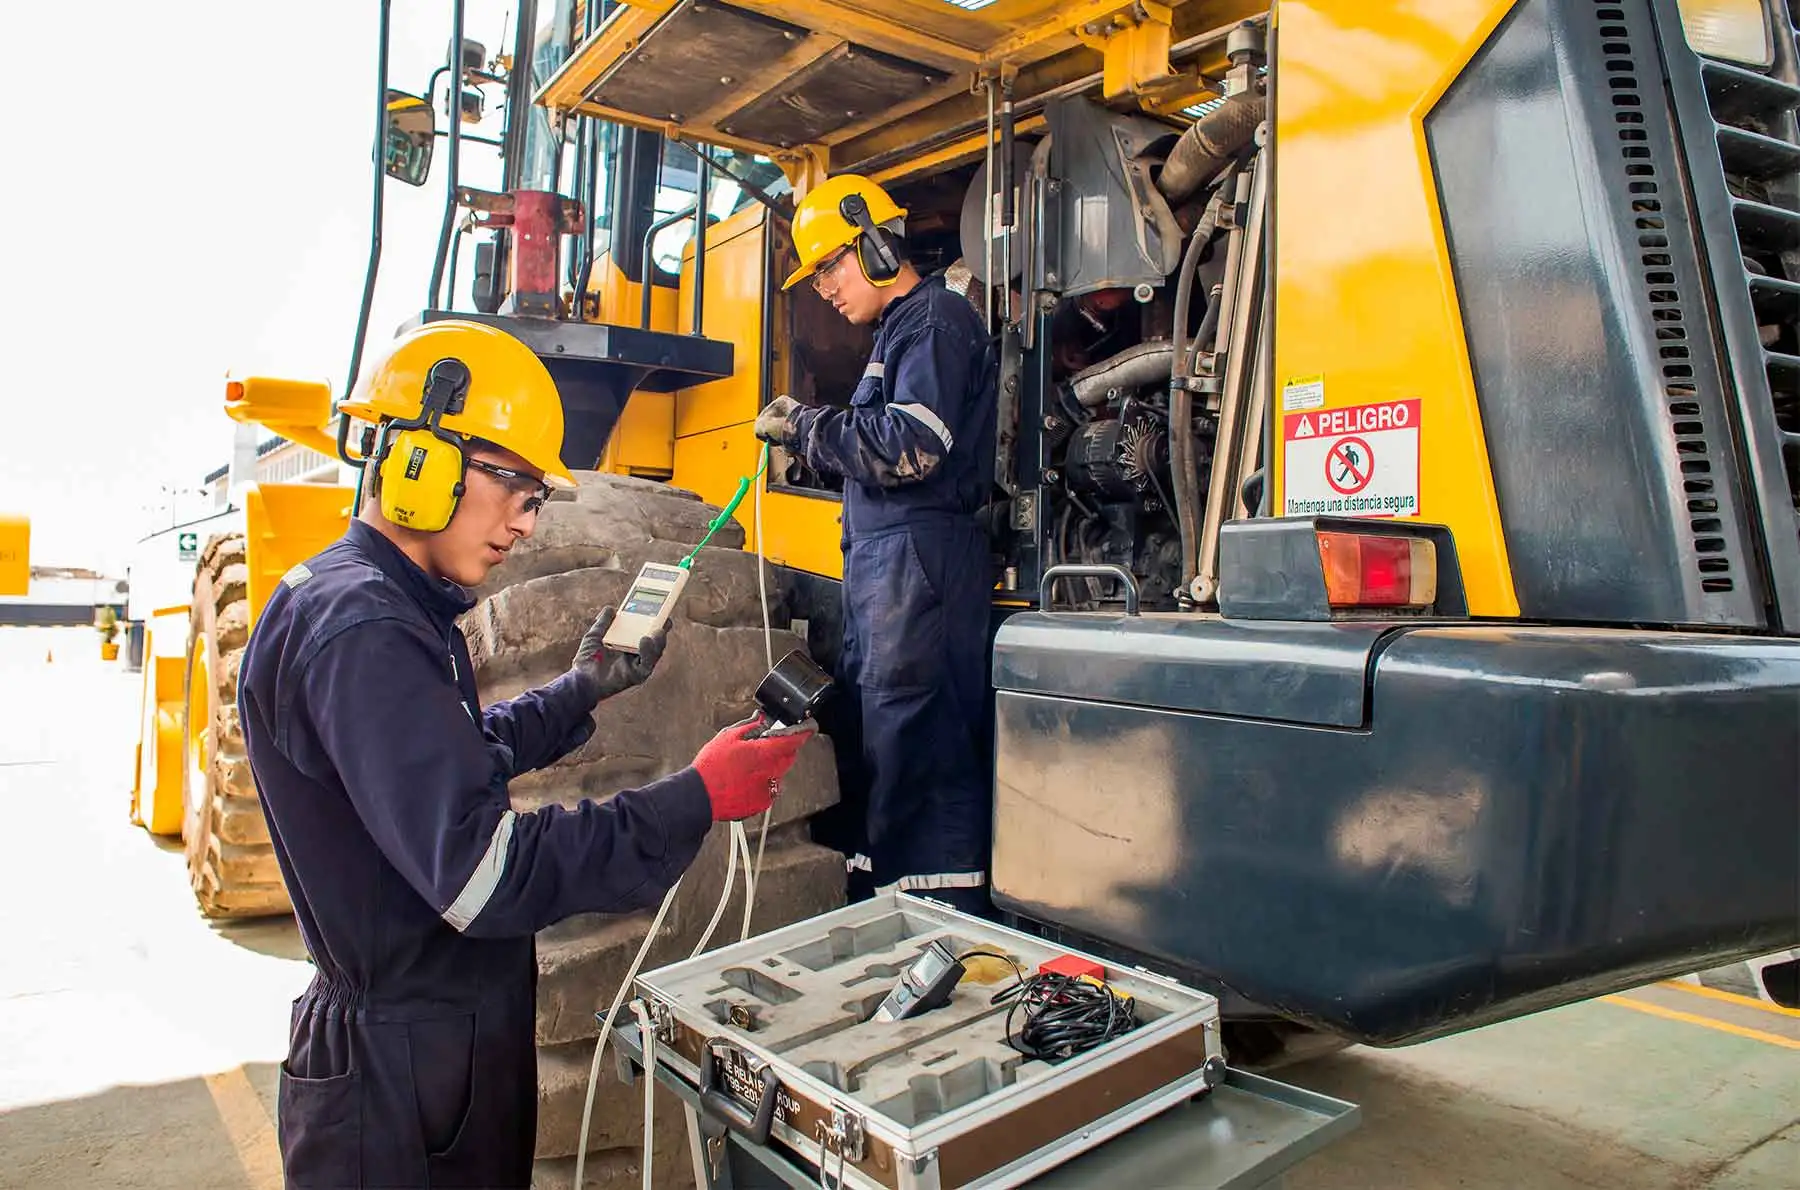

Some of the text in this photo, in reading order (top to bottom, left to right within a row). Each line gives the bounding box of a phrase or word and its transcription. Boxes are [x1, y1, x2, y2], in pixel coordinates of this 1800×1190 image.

[1318, 404, 1409, 435] PELIGRO
[1327, 500, 1341, 512] una
[1344, 494, 1381, 511] distancia
[1383, 495, 1415, 512] segura
[777, 1091, 800, 1115] ROUP
